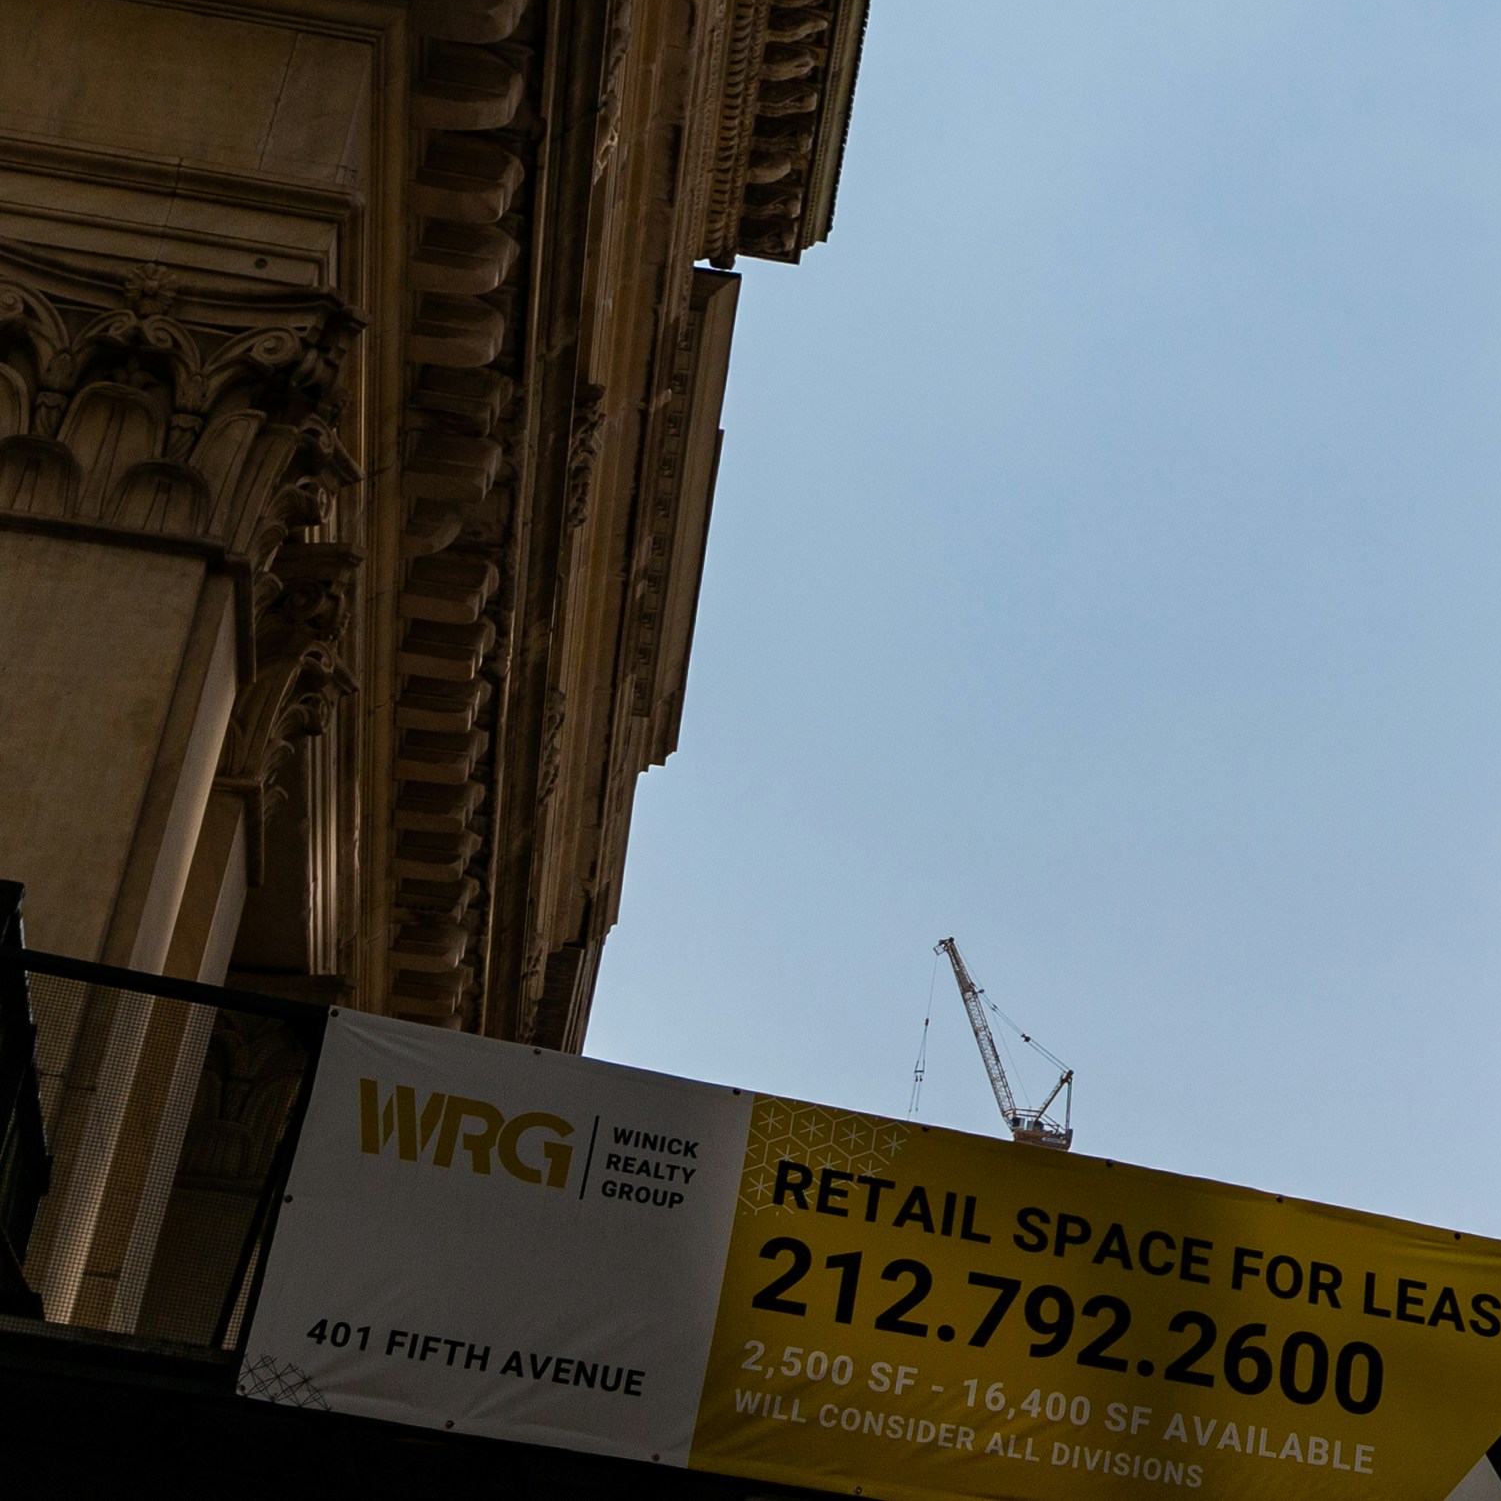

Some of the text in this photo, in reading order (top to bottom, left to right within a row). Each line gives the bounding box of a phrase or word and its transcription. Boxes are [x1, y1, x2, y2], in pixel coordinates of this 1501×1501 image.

[360, 1078, 575, 1189] WRG
[605, 1154, 696, 1185] REALTY
[612, 1126, 700, 1159] WINICK
[600, 1180, 684, 1209] GROUP
[771, 1159, 992, 1244] RETAIL
[1013, 1207, 1213, 1284] SPACE
[1231, 1246, 1343, 1309] FOR
[306, 1318, 645, 1397] 401 FIFTH AVENUE
[751, 1236, 1384, 1415] 212.792.2600
[733, 1389, 1204, 1488] WILL CONSIDER ALL DIVISIONS
[741, 1340, 853, 1386] 2,500
[868, 1361, 918, 1396] SF
[963, 1378, 1091, 1426] 16,400
[1104, 1402, 1153, 1436] SF
[1163, 1412, 1375, 1475] AVAILABLE
